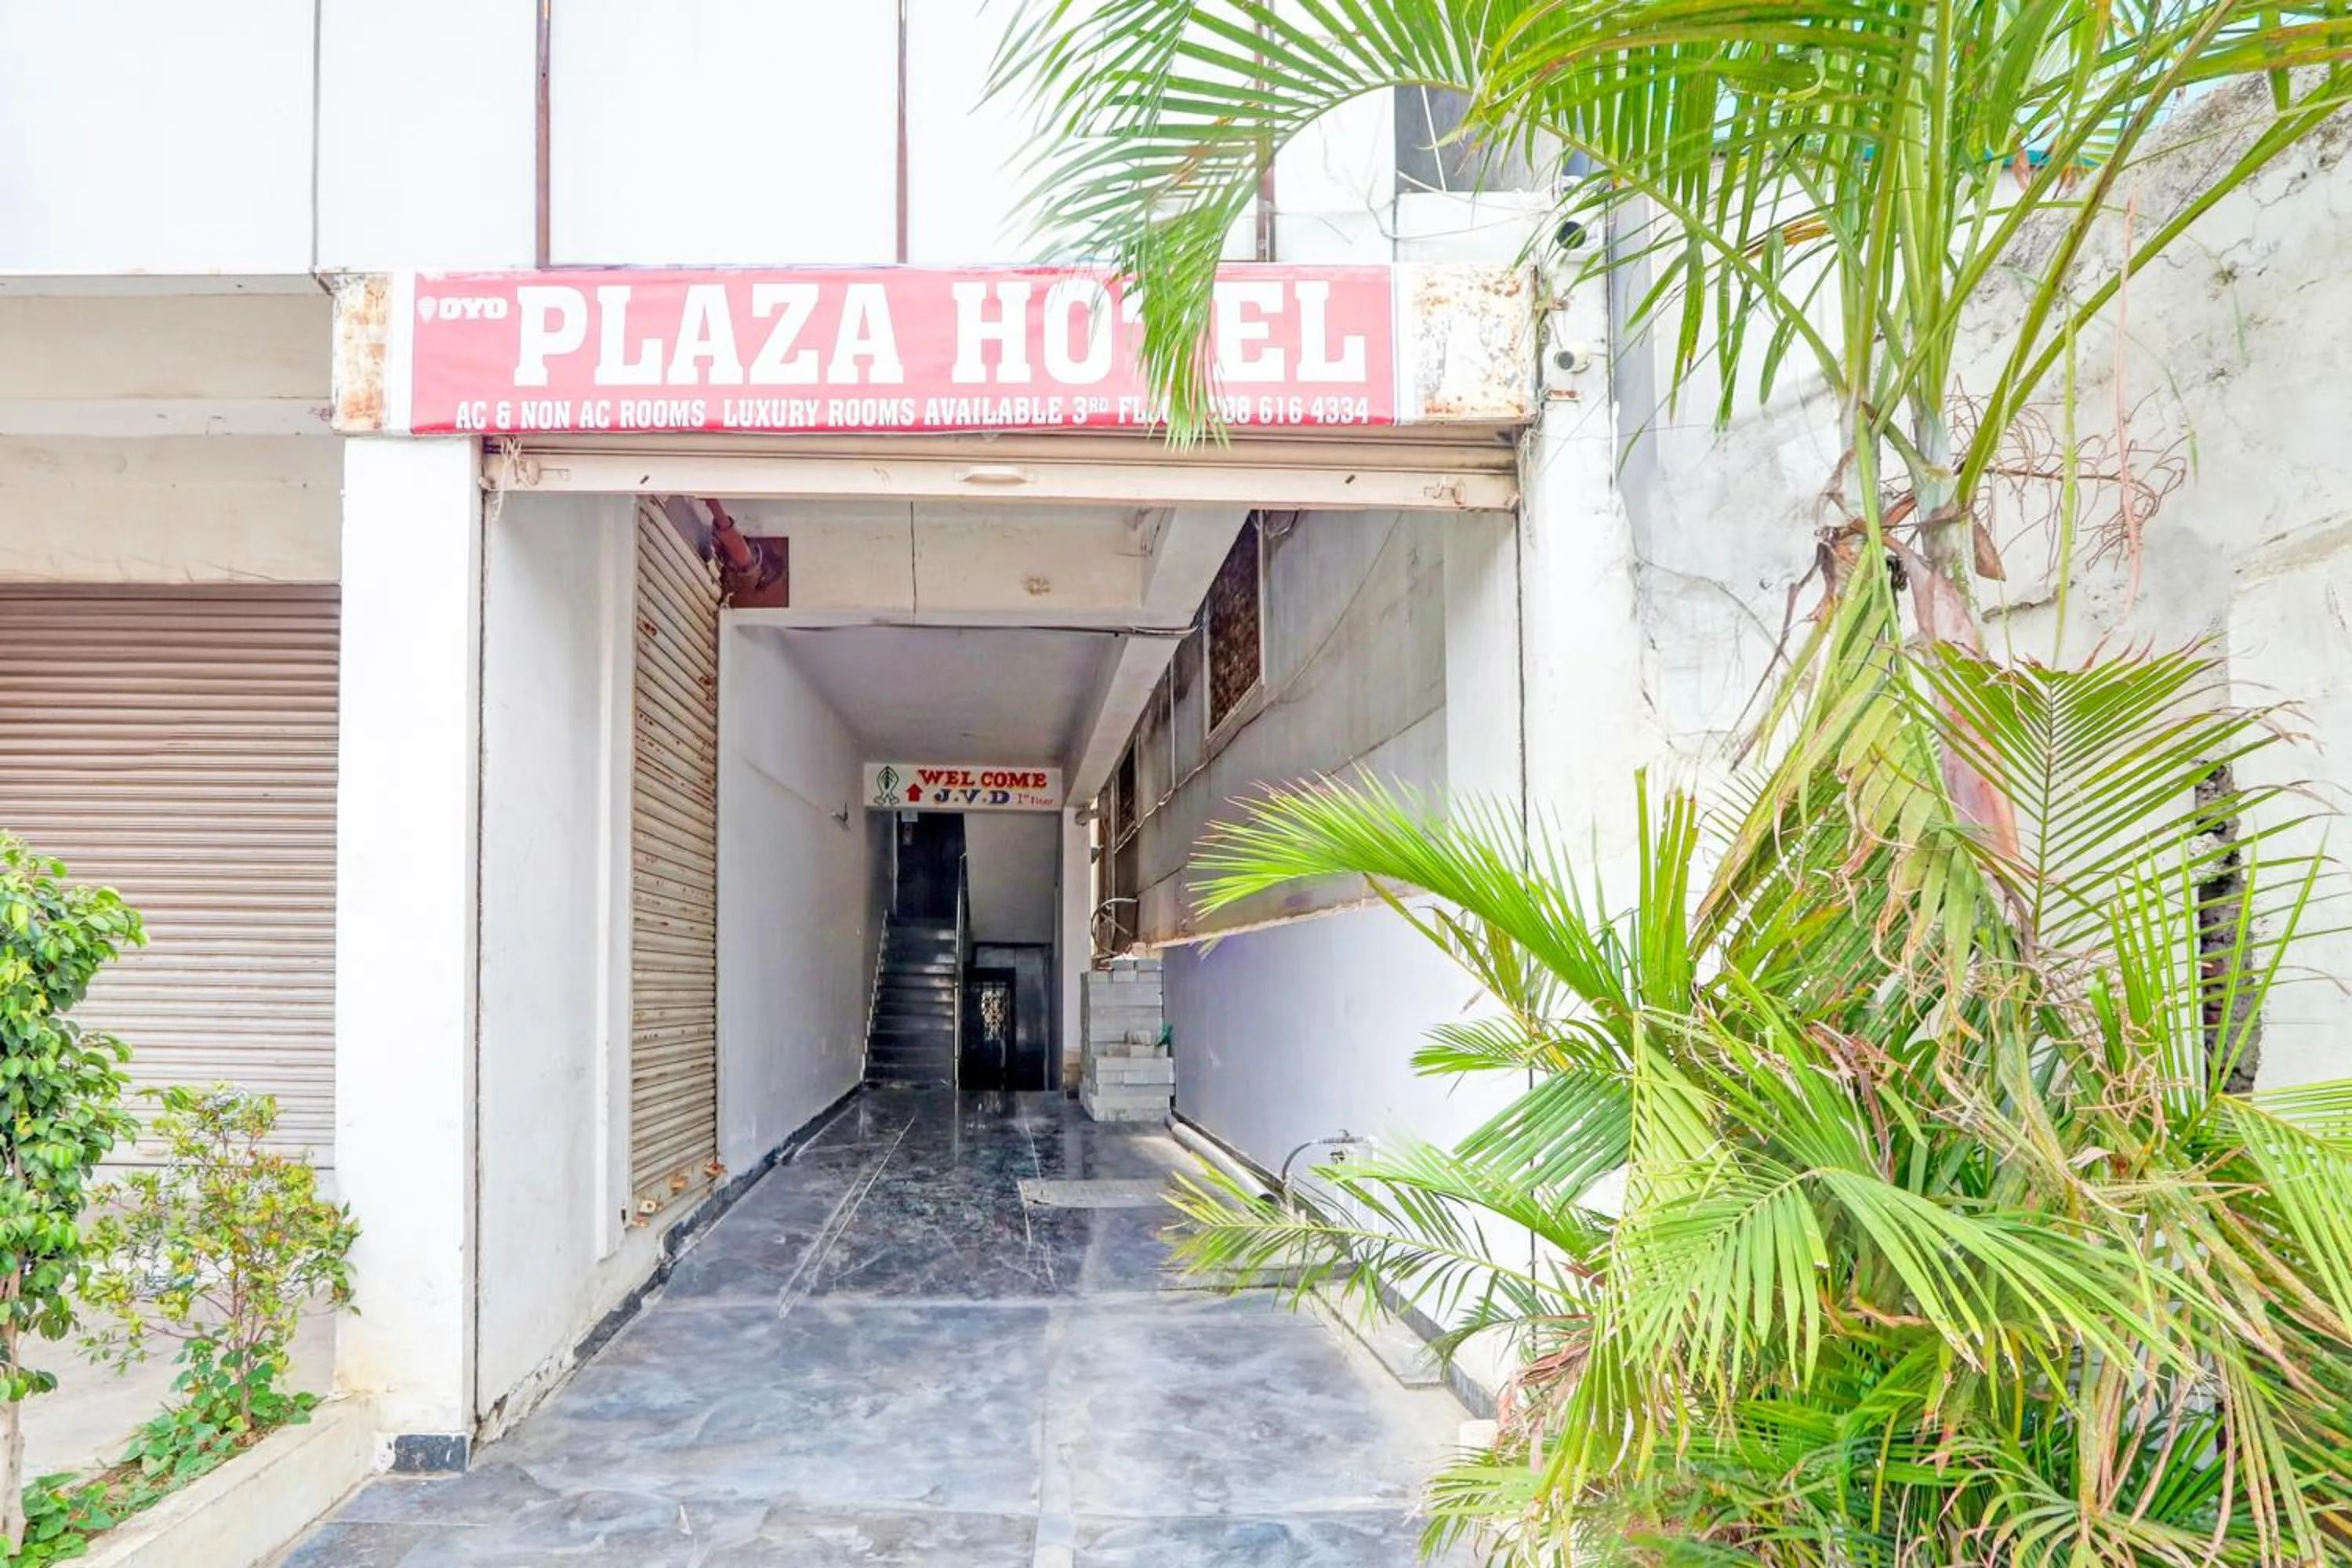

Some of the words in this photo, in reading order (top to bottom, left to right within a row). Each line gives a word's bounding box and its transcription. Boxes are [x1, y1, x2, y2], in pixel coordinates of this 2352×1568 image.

[439, 297, 508, 319] OYO
[514, 283, 904, 386] PLAZA
[456, 401, 487, 430] AC
[495, 401, 513, 429] &
[521, 401, 572, 429] NON
[579, 401, 610, 428] AC
[619, 399, 706, 428] ROOMS
[723, 399, 819, 427] LUXURY
[827, 397, 915, 426] ROOMS
[924, 397, 1063, 426] AVAILABLE
[1072, 397, 1109, 425] 3RD
[1258, 396, 1303, 424] 616
[1310, 396, 1370, 424] 4334
